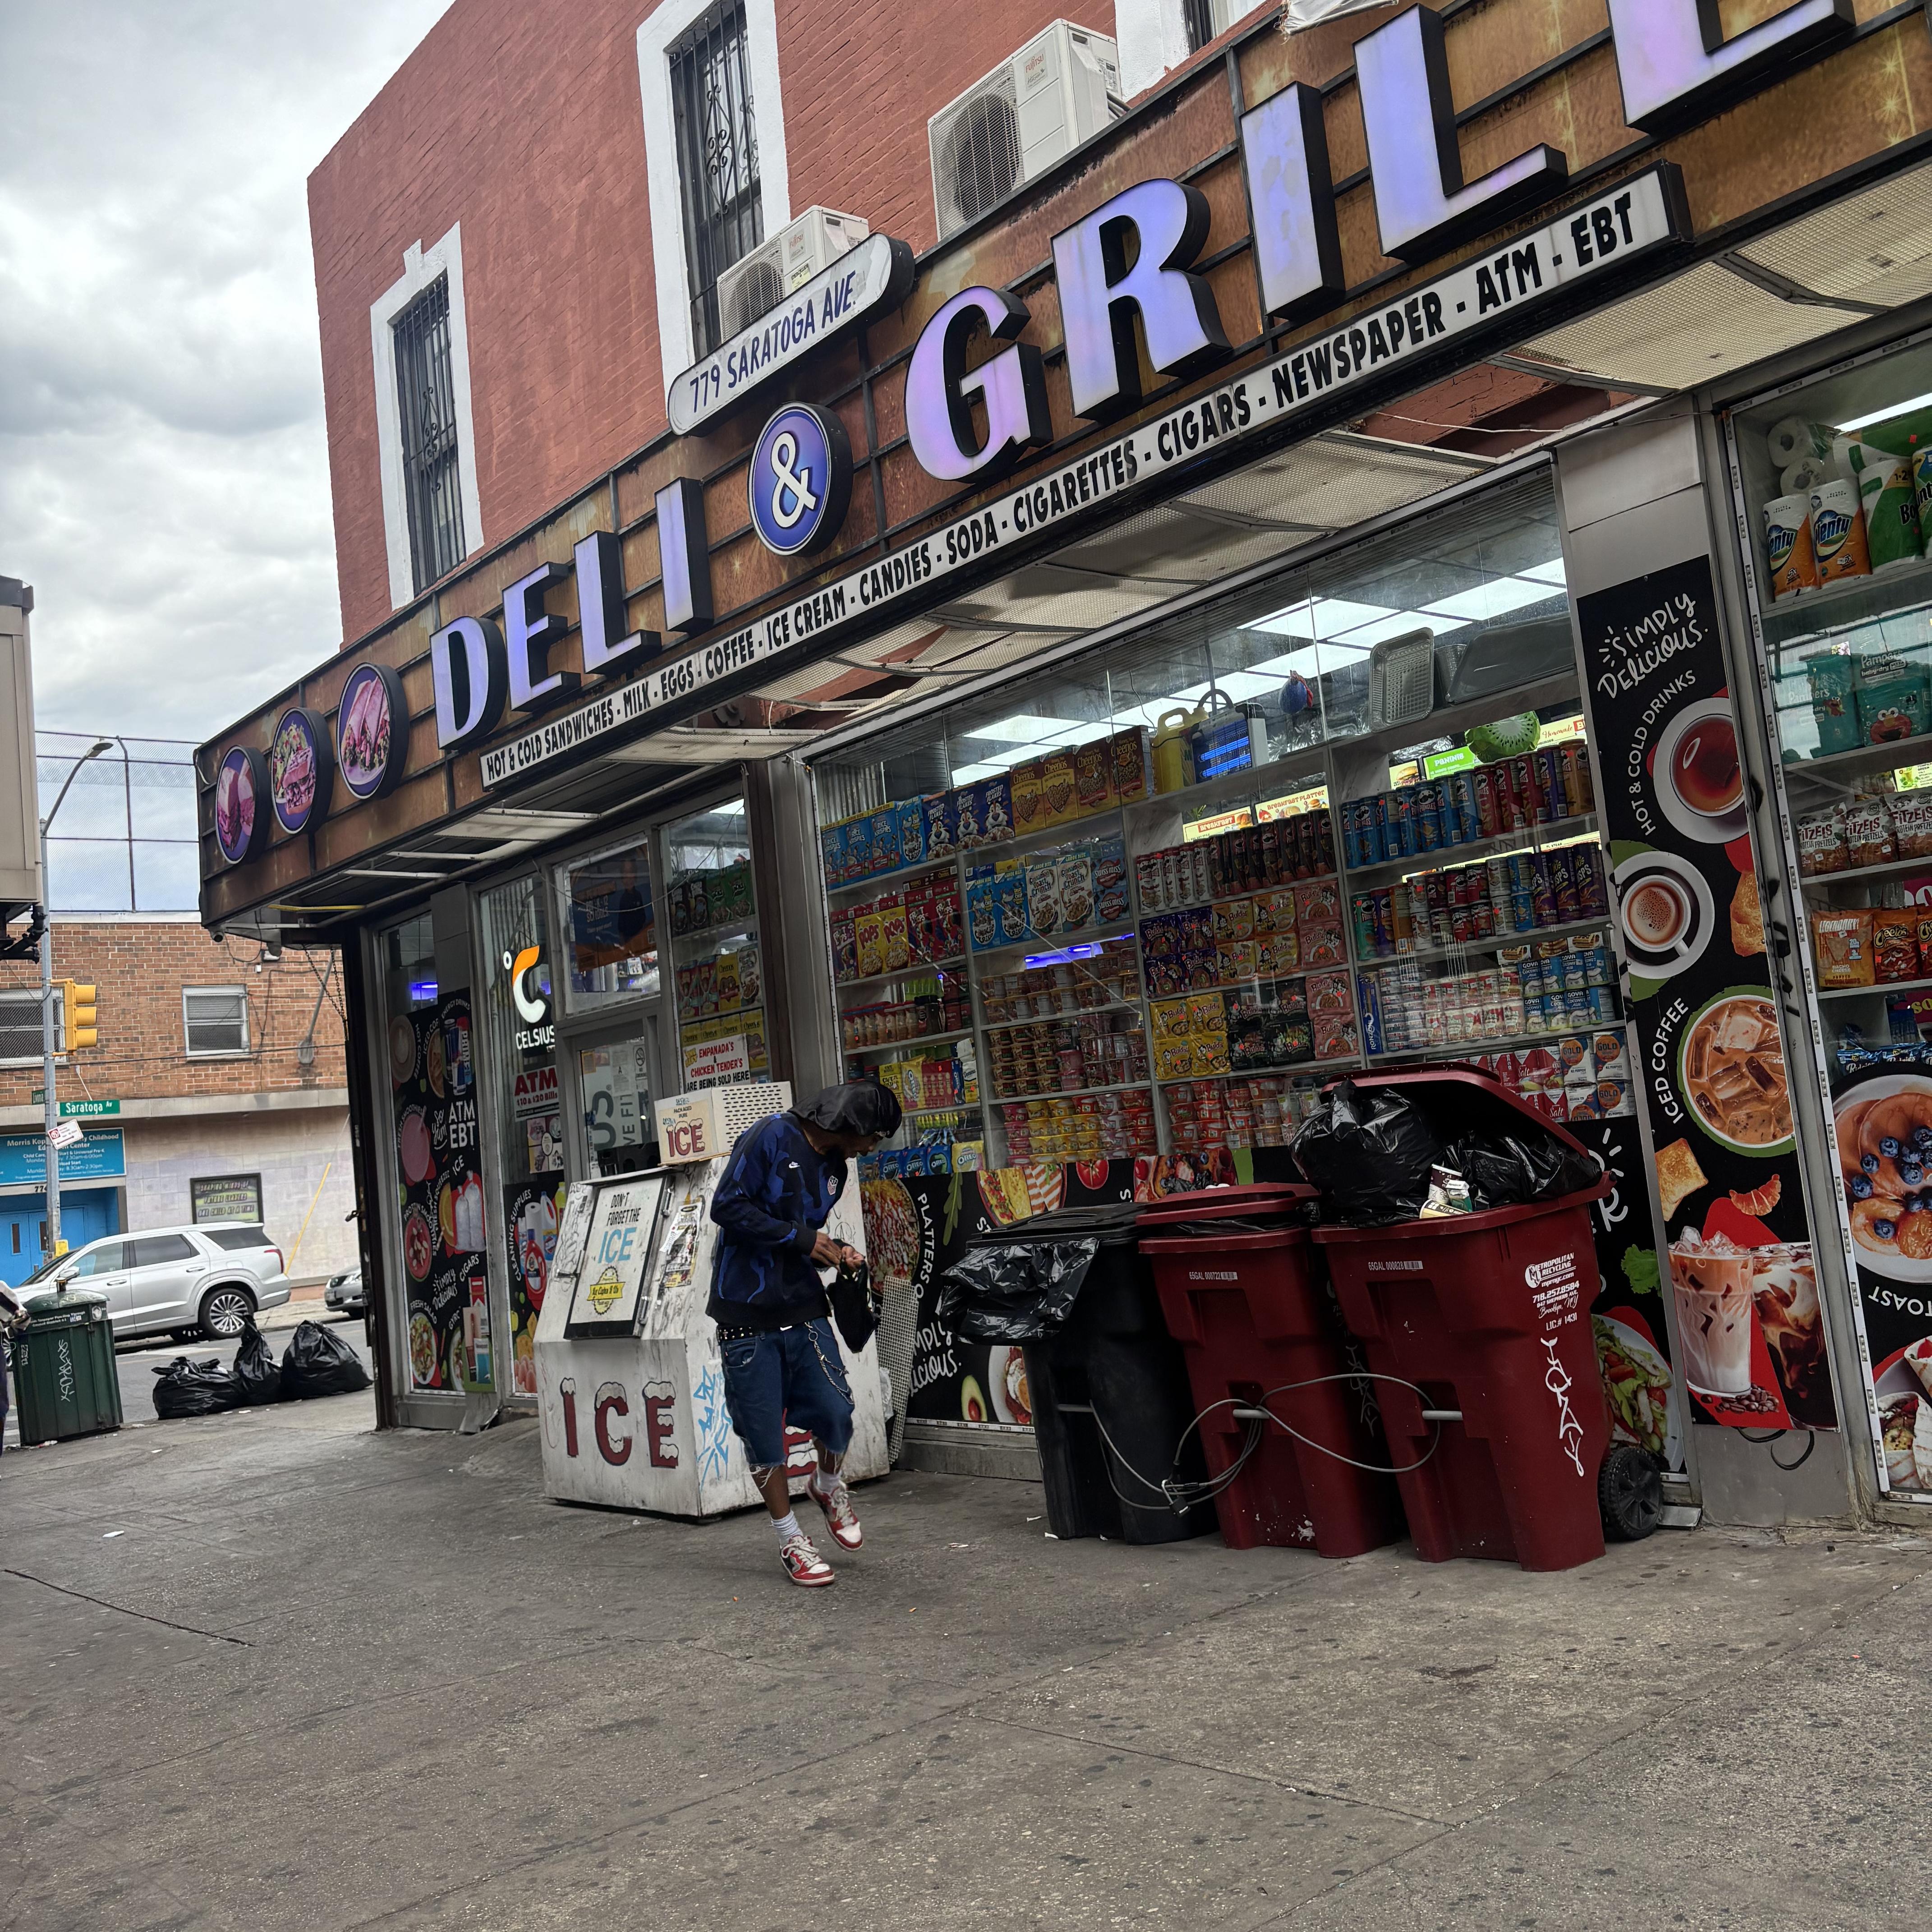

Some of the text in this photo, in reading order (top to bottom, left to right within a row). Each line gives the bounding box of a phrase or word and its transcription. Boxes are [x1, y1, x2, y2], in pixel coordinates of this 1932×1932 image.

[1025, 54, 1044, 73] FUJITSU
[690, 269, 856, 413] 779 SARATOGA AVE.
[486, 192, 1632, 781] HOT & COLD SANDWICHES MILK EGGS COFFEE ICE CREAM CANDIES SODA CIGARETTES CIGARS NEWSPAPER ATM EBT
[1769, 530, 1796, 556] enty
[430, 477, 713, 750] DELI
[771, 431, 817, 528] &
[1111, 741, 1137, 757] Cheerios
[1628, 669, 1697, 837] HOT & COLD DRINKS
[1044, 759, 1067, 774] Cheerios
[1077, 752, 1102, 768] Cheerios
[1013, 771, 1035, 784] Cheerios
[985, 784, 1003, 798] FROSTED
[986, 791, 1002, 803] FLAKES
[927, 803, 945, 816] FROSTED
[929, 810, 943, 821] FLAKES
[1815, 837, 1836, 848] PRETZELS
[1862, 831, 1884, 841] PRETZELS
[859, 924, 879, 950] POPS
[883, 917, 906, 944] POPS
[1875, 925, 1908, 948] Cheetos
[441, 998, 471, 1019] ENERGY DRINKS
[515, 1025, 555, 1050] CELSIUS
[1597, 1042, 1617, 1052] GOLD
[699, 1041, 734, 1058] EMPANADA'S
[1563, 1046, 1581, 1056] GOLD
[414, 1044, 422, 1080] COFFEE
[691, 1058, 743, 1078] CHICKEN TENDER'S
[1651, 997, 1689, 1125] ICED COFFEE
[514, 1067, 558, 1096] ATM
[687, 1070, 750, 1092] ARE BEING SOLD HERE
[907, 1070, 917, 1099] OREO
[1600, 1090, 1618, 1099] GOLD
[66, 1102, 103, 1114] Saratoga
[449, 1099, 475, 1123] ATM
[1549, 1106, 1563, 1118] Salt
[7, 1139, 31, 1147] Morris
[89, 1133, 119, 1141] Childhood
[450, 1121, 476, 1150] EBT
[666, 1118, 705, 1158] ICE
[452, 1155, 465, 1176] ICE
[882, 1162, 899, 1173] OREO
[906, 1161, 924, 1173] OREO
[931, 1158, 946, 1168] OREO
[957, 1152, 977, 1165] OREO
[611, 1192, 630, 1209] DON'T
[607, 1207, 641, 1226] FORGET THE
[509, 1188, 532, 1282] CLEANING SUPPLIES
[917, 1192, 935, 1284] PLATTERS
[598, 1227, 637, 1264] ICE
[459, 1254, 479, 1282] CIGARS
[1368, 1261, 1386, 1271] 65GAL
[1530, 1252, 1574, 1272] METROPOLITAN
[1542, 1260, 1571, 1276] RECYCLING
[1189, 1271, 1205, 1280] 65GAL
[1868, 1286, 1932, 1316] TOAST
[1564, 1312, 1578, 1325] 1431
[560, 1376, 679, 1469] ICE
